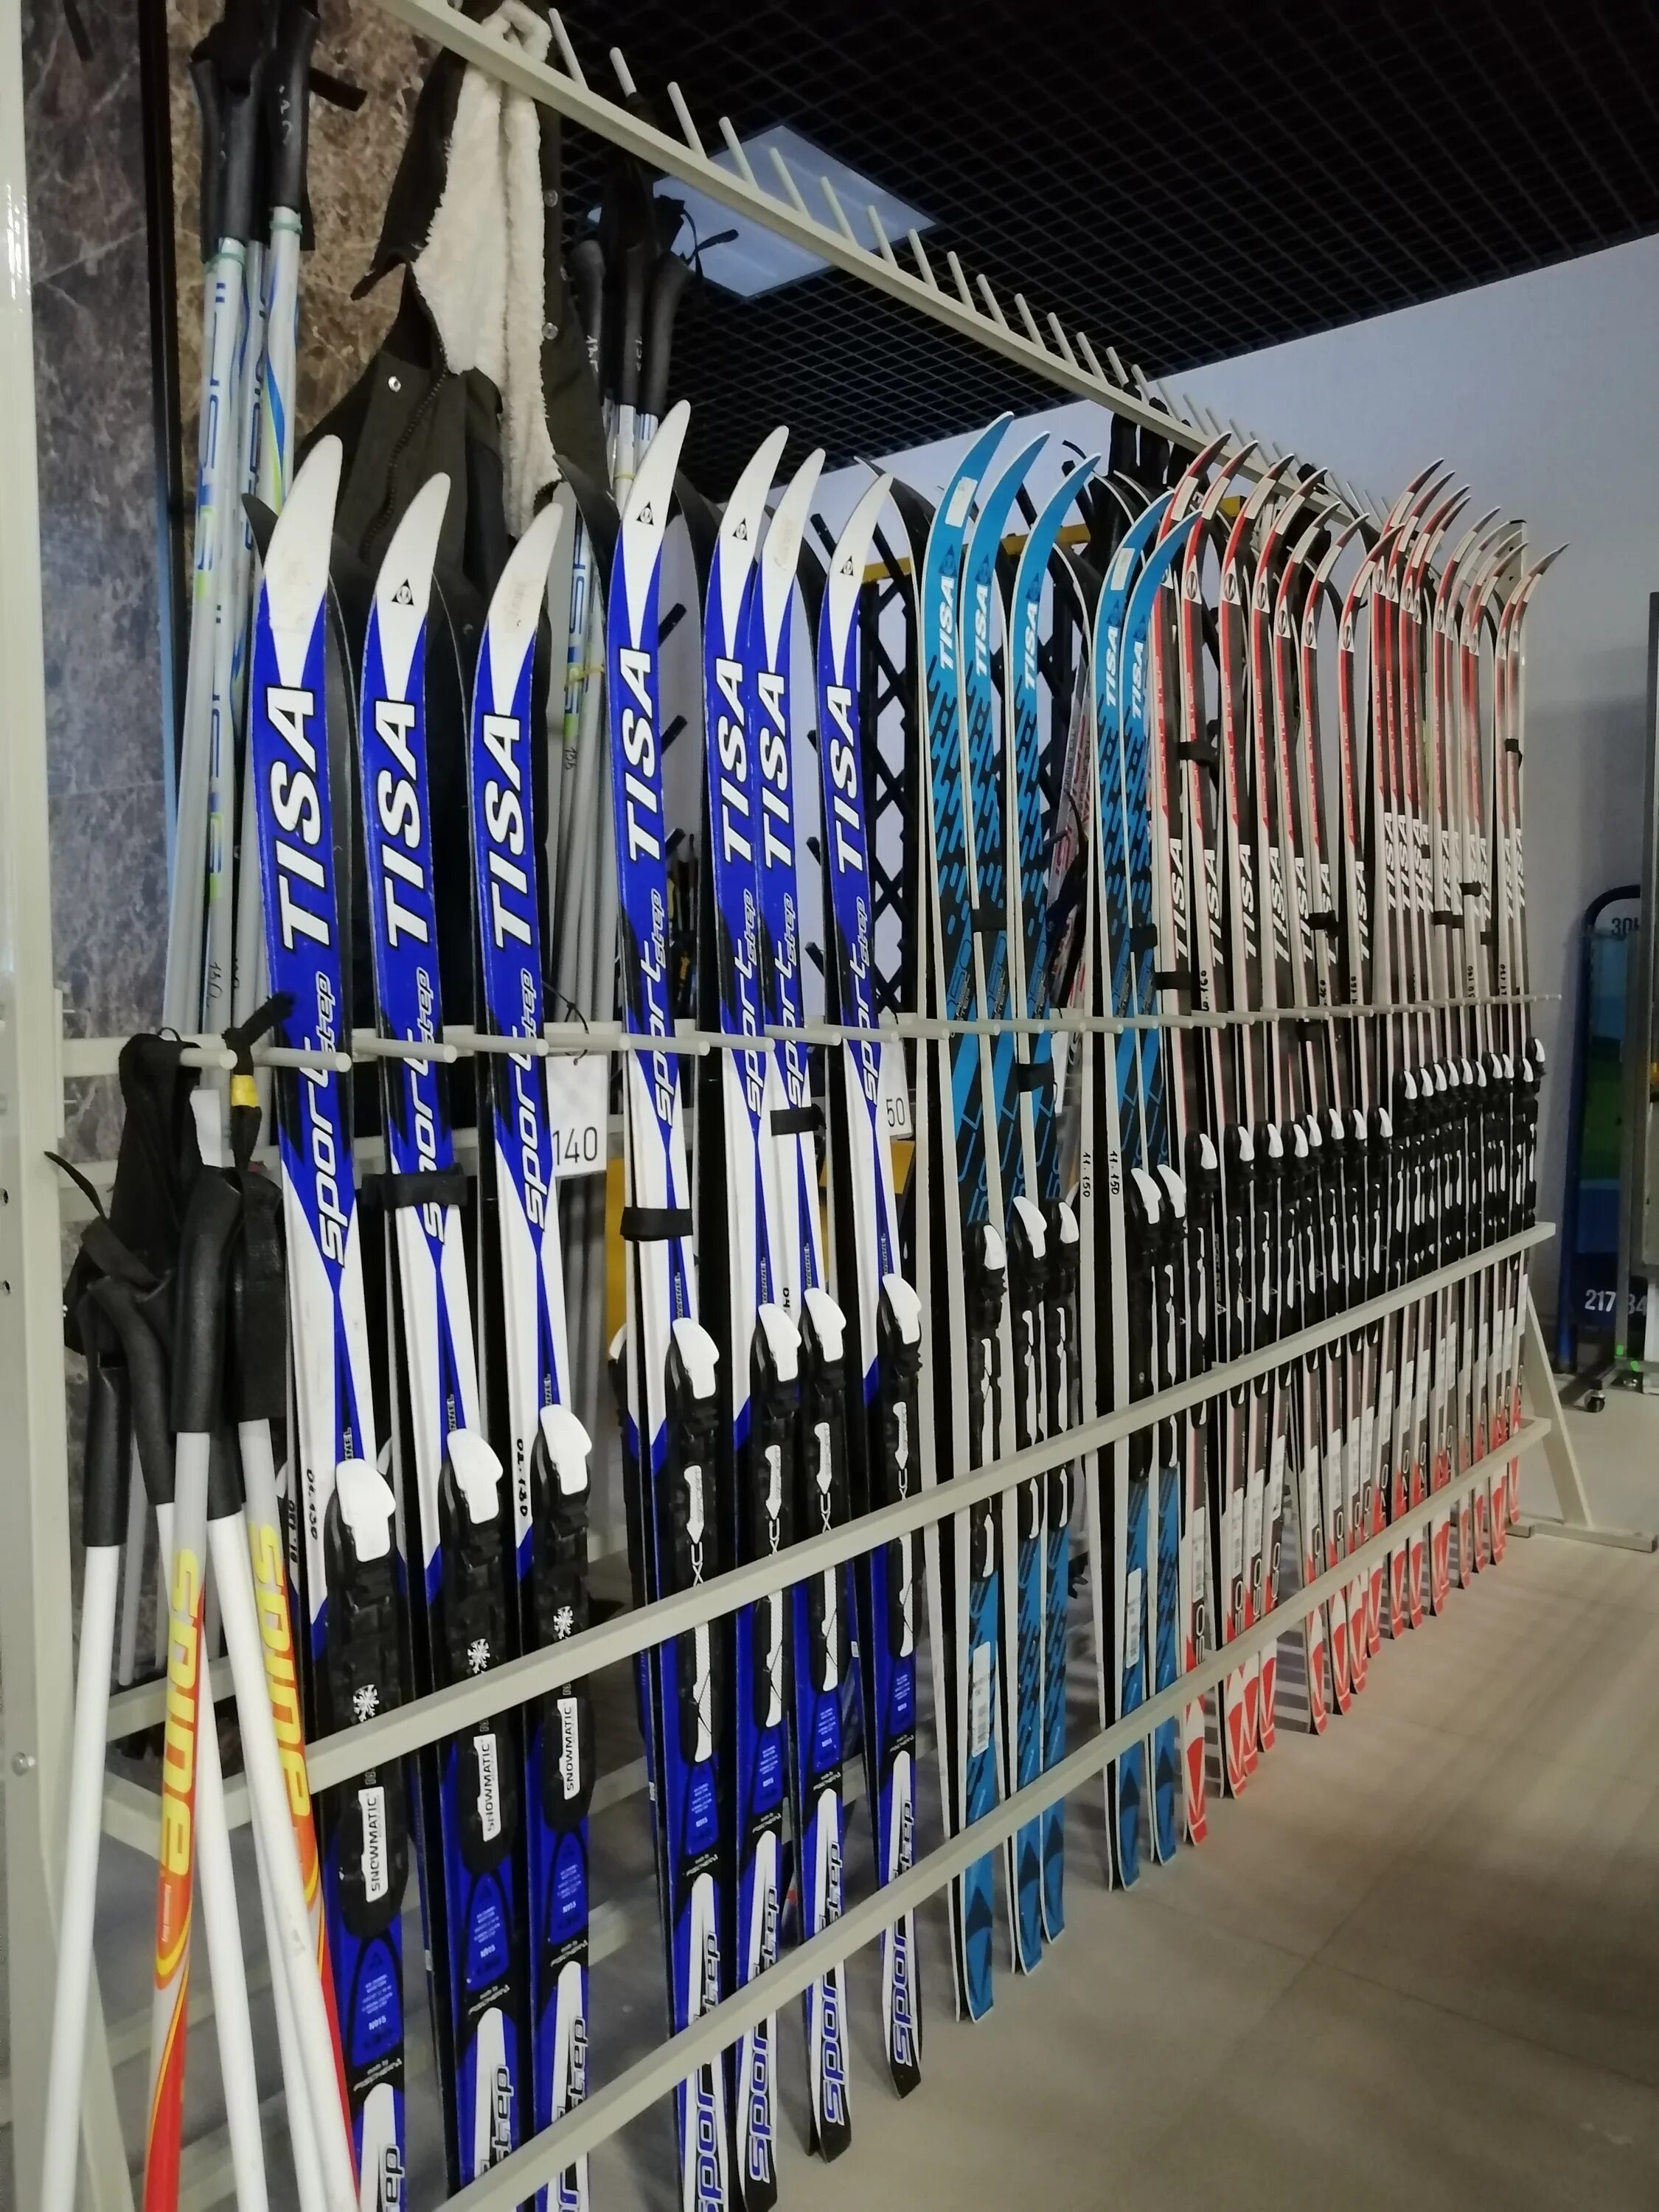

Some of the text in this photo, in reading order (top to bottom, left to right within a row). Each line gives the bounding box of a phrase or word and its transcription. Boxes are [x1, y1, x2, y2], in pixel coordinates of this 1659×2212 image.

[939, 577, 954, 670] TISA
[975, 584, 988, 676] TISA
[1025, 602, 1038, 689] TISA
[1106, 626, 1119, 706] TISA
[1132, 641, 1144, 719] TISA
[619, 647, 661, 862] TISA
[715, 657, 752, 863] TISA
[757, 672, 792, 869] TISA
[827, 685, 863, 874] TISA
[266, 686, 331, 951] TISA
[375, 700, 428, 949] TISA
[483, 714, 532, 951] TISA
[1385, 813, 1396, 910] TISA
[1398, 815, 1411, 910] TISA
[1413, 819, 1425, 911] TISA
[1169, 838, 1188, 959] TISA
[1204, 849, 1224, 967] TISA
[1239, 845, 1256, 959] TISA
[1270, 848, 1284, 960] TISA
[1295, 858, 1312, 961] TISA
[1321, 864, 1336, 966] TSA
[1355, 861, 1369, 961] TISA
[641, 888, 674, 1127] sport step
[735, 888, 762, 1117] sport step
[775, 892, 804, 1107] sport step
[850, 897, 877, 1107] sport step
[299, 1035, 345, 1267] sport
[403, 1028, 445, 1245] sort
[509, 1026, 546, 1231] sport
[552, 1125, 598, 1166] 140
[886, 1097, 905, 1127] 50
[1585, 1289, 1616, 1312] 217
[481, 1743, 495, 1832] SNOWMATIC
[563, 1705, 574, 1791] SNOWMATIC
[368, 1795, 380, 1892] SNOWMATIC
[821, 1967, 845, 2126] spor
[893, 1919, 912, 2067] spor
[695, 1930, 723, 2212] por tep
[748, 2025, 773, 2183] spor
[383, 2144, 405, 2212] ep
